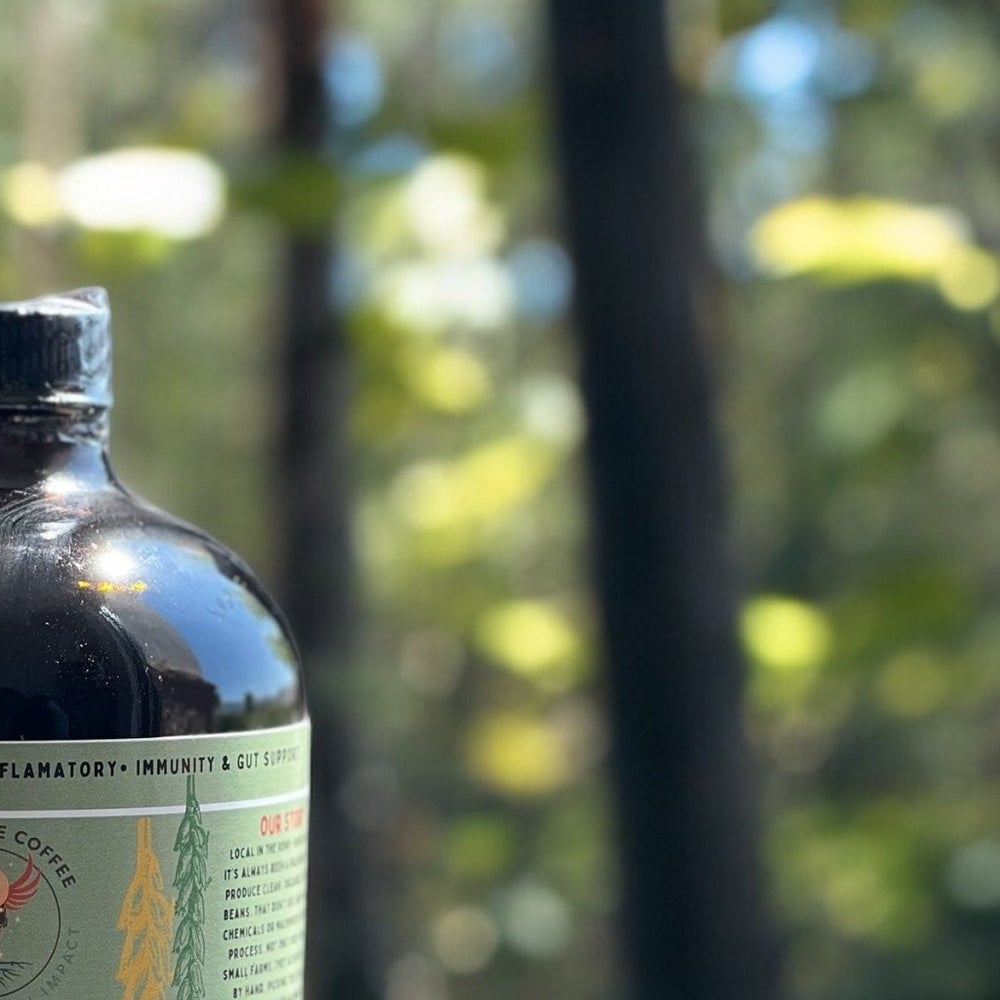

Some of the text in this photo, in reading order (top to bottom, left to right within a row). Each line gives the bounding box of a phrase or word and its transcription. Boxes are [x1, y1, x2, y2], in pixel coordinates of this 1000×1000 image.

[136, 756, 215, 776] IMMUNITY
[222, 756, 230, 771] &
[237, 752, 258, 769] GUT
[260, 814, 281, 836] OUR
[14, 830, 77, 889] COFFEE
[230, 847, 255, 860] LOCAL
[224, 868, 239, 881] IT'S
[242, 864, 269, 878] ALWAYS
[225, 885, 260, 901] PRODUCE
[255, 902, 270, 915] THAT
[223, 925, 265, 941] CHEMICALS
[40, 927, 80, 996] IMPACT
[223, 966, 248, 981] SMALL
[233, 983, 264, 999] BY HAND
